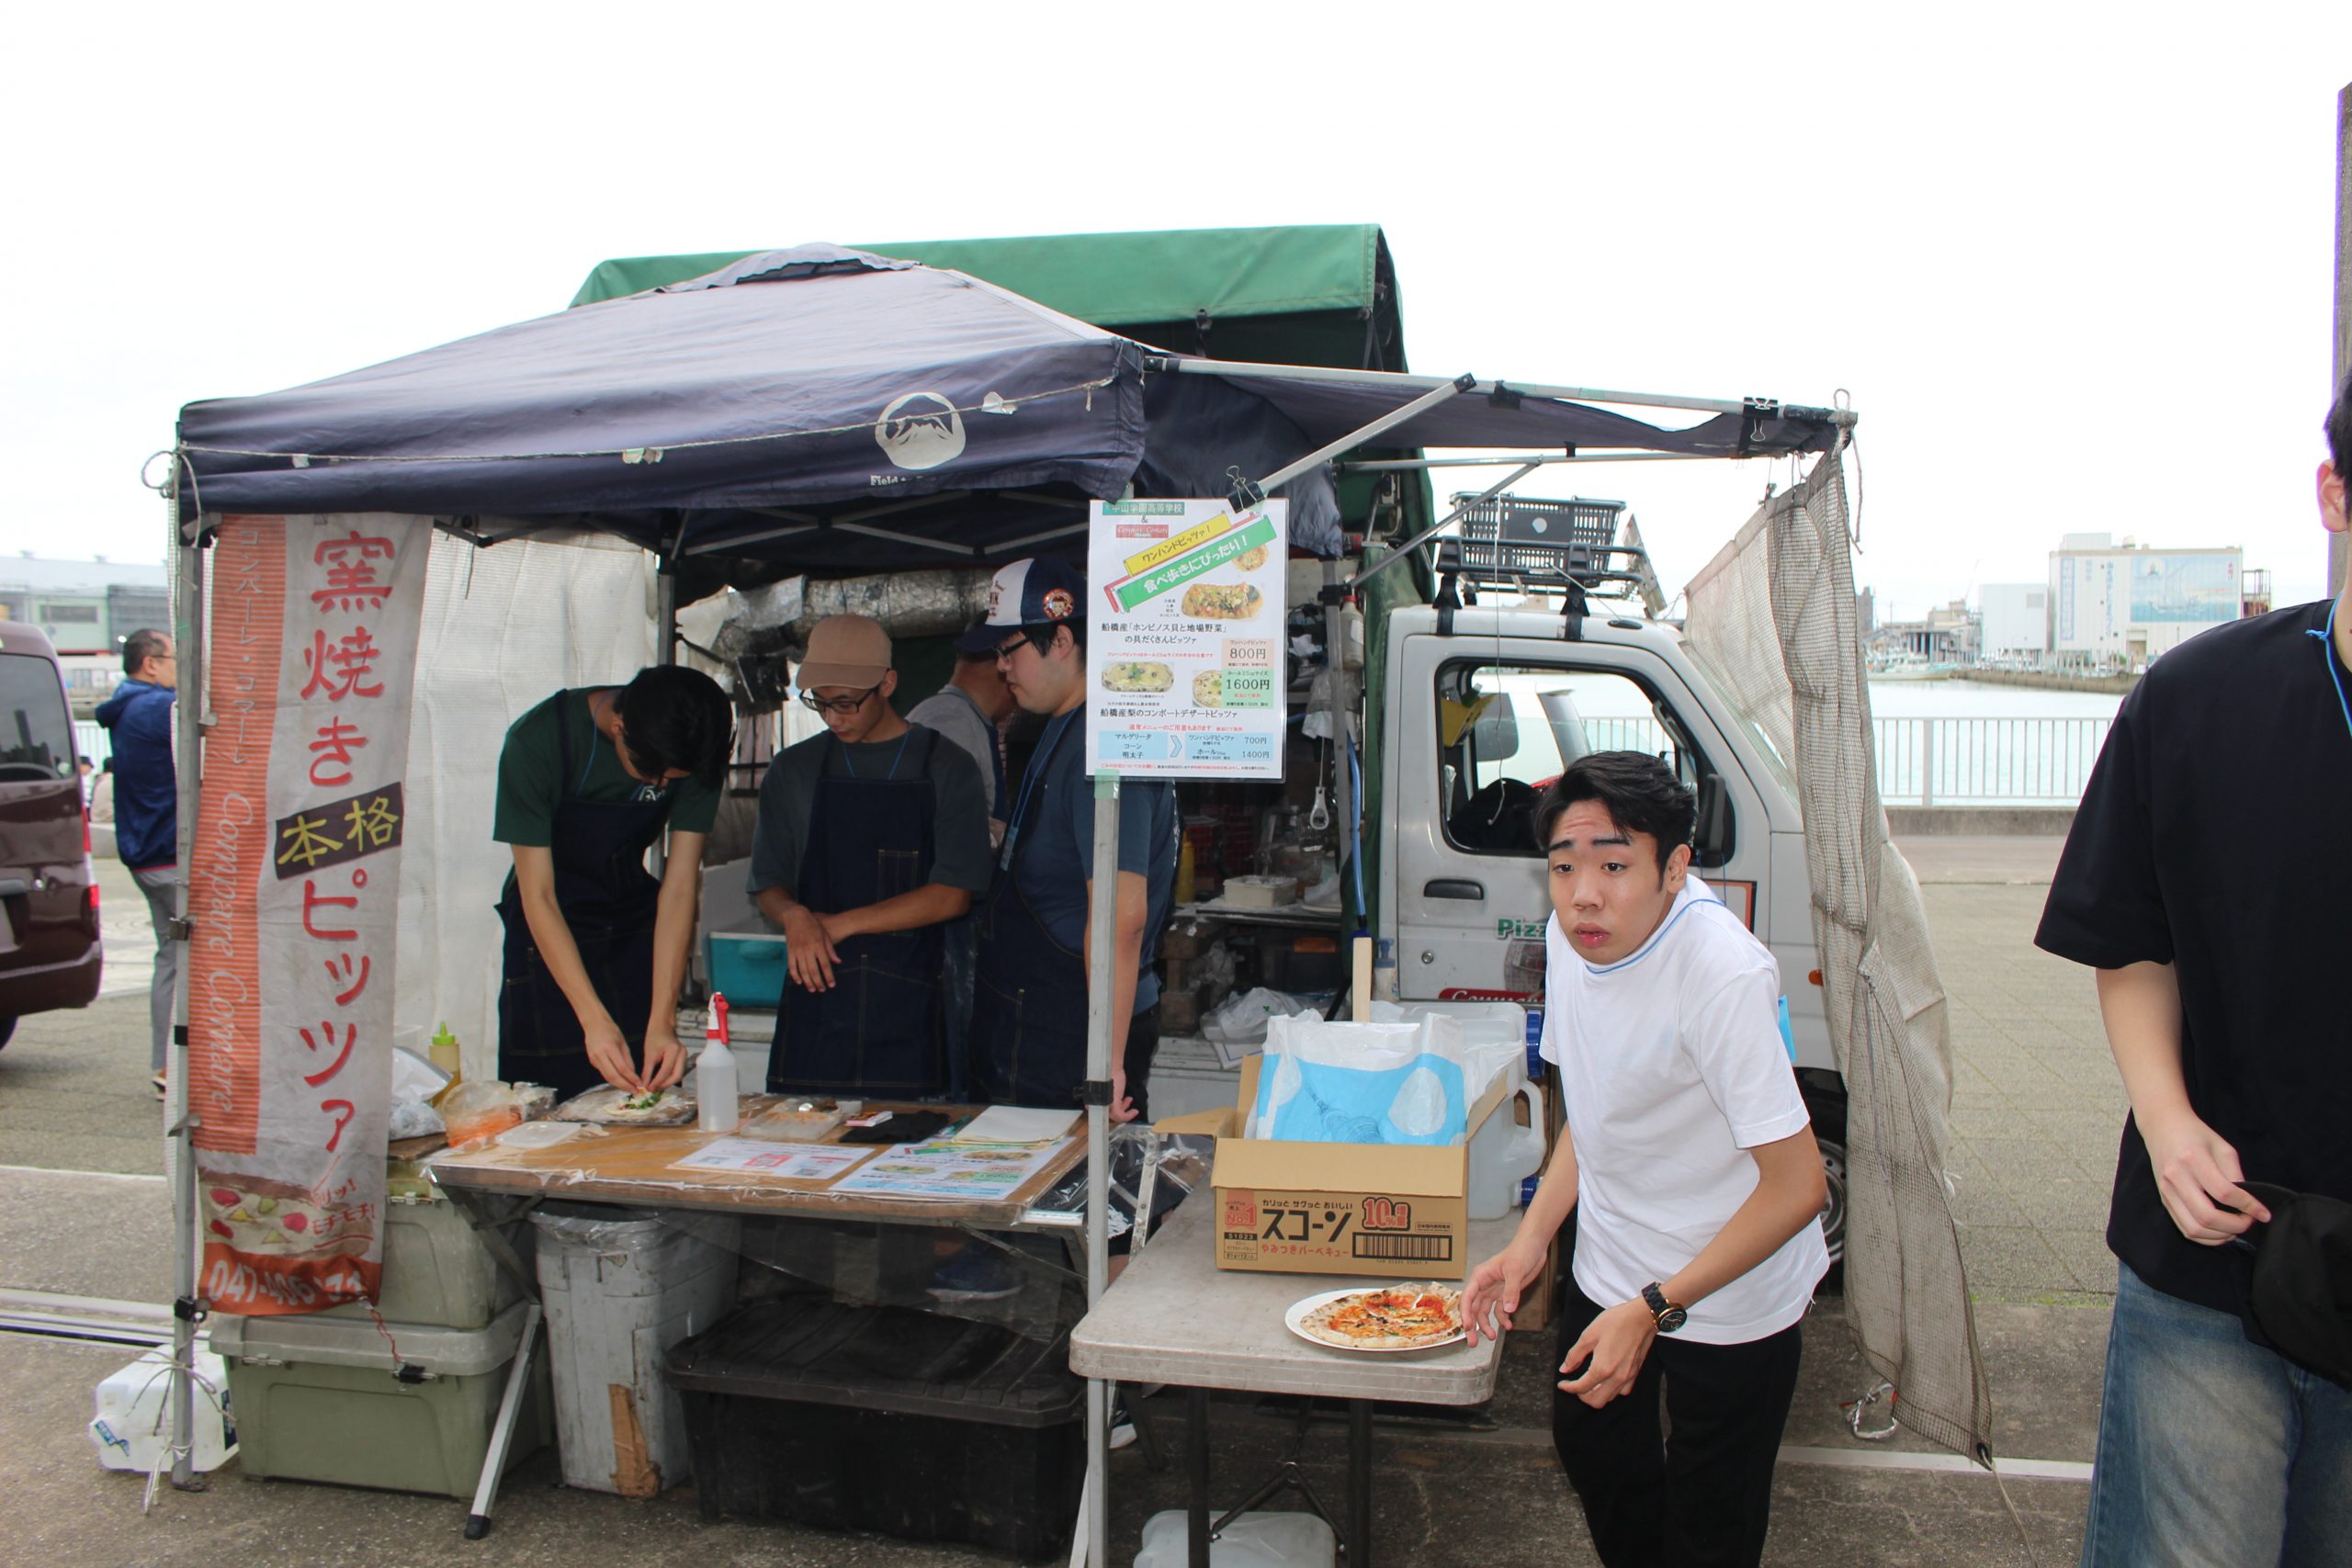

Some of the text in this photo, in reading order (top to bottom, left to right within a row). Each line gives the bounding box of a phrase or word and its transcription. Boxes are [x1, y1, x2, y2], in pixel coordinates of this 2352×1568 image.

[300, 530, 395, 788] 窯焼き
[1229, 648, 1266, 660] 800円
[1226, 678, 1270, 690] 1600円
[1244, 737, 1267, 745] 700円
[1242, 750, 1270, 759] 1400円
[277, 795, 399, 866] 本格
[300, 867, 372, 1154] ピッツァ
[1261, 1208, 1352, 1243] スコーン
